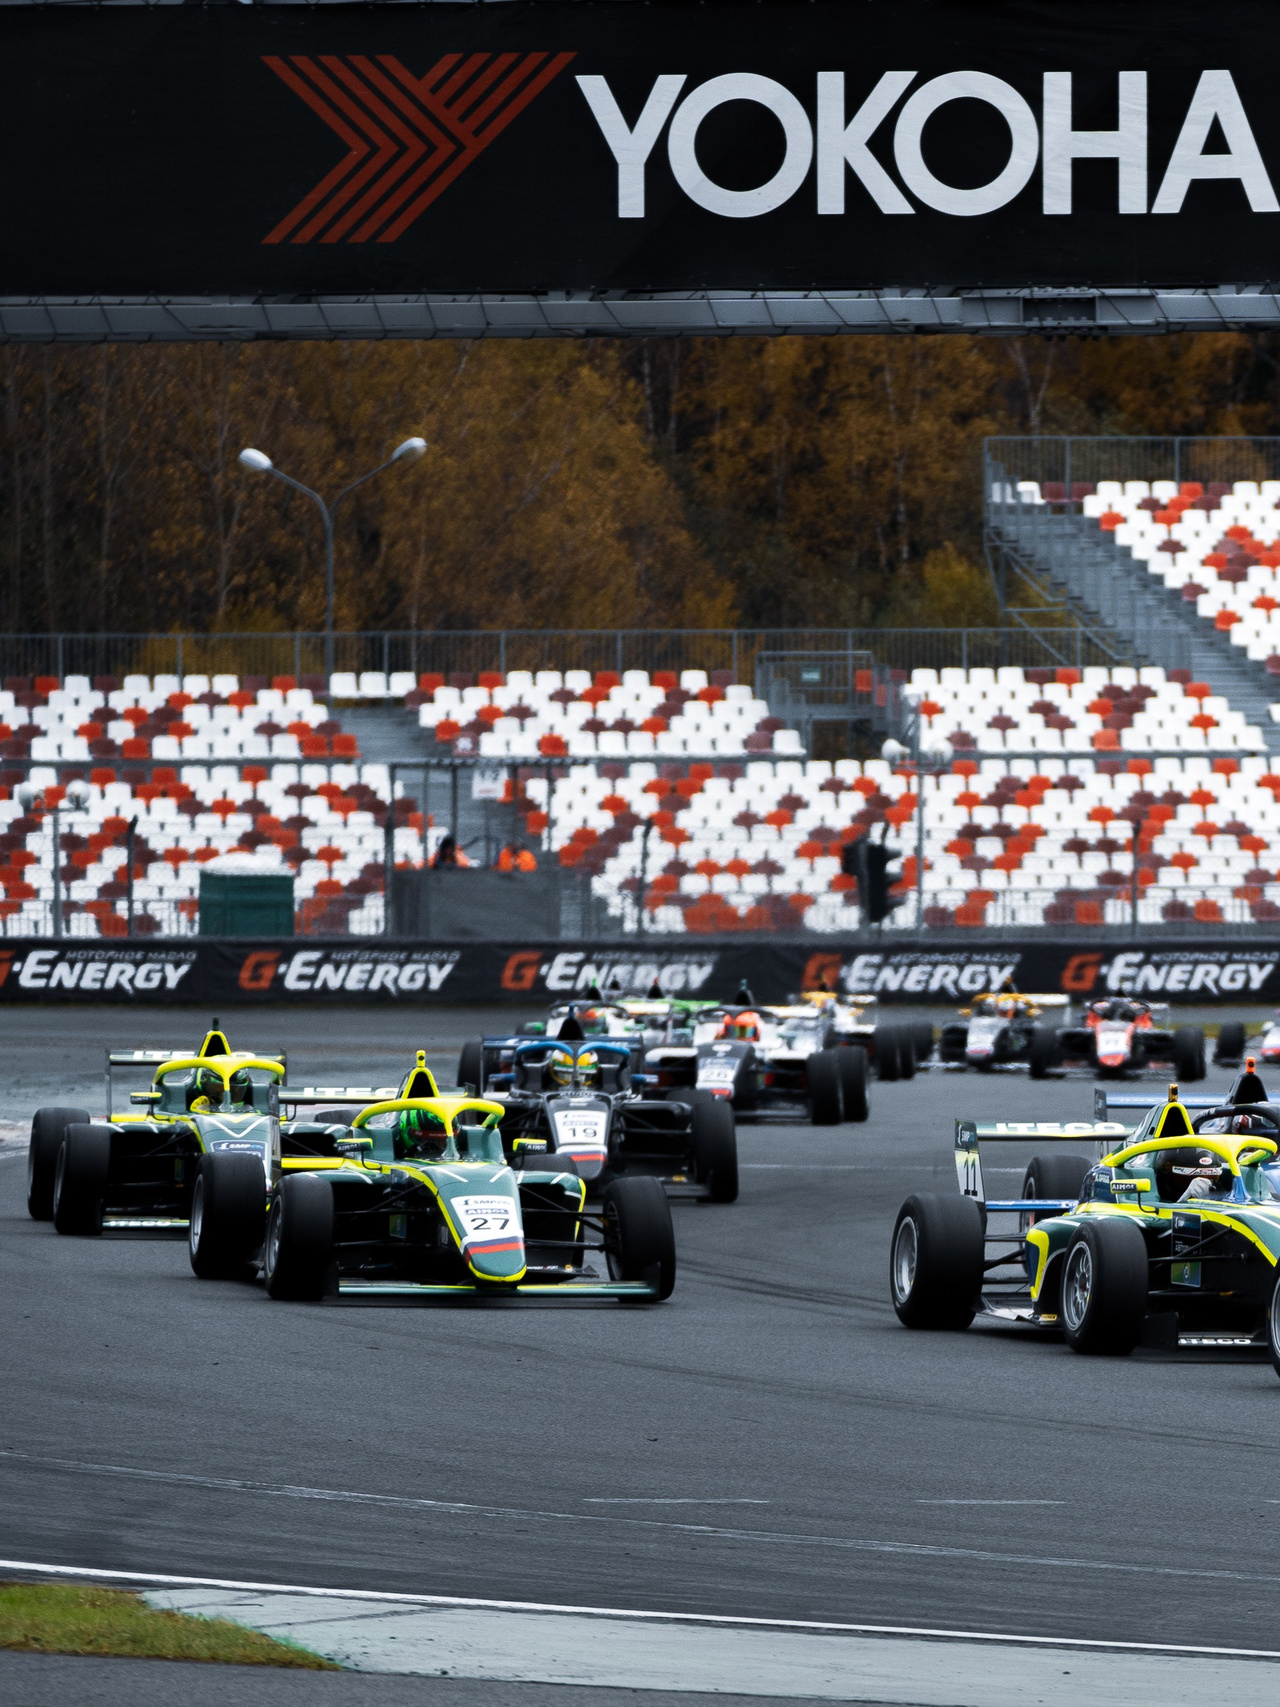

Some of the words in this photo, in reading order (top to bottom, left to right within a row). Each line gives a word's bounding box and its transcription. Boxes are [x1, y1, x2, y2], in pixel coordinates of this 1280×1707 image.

[567, 1127, 598, 1138] 19
[996, 1122, 1126, 1134] ITECO
[963, 1156, 978, 1197] 11
[470, 1217, 510, 1231] 27
